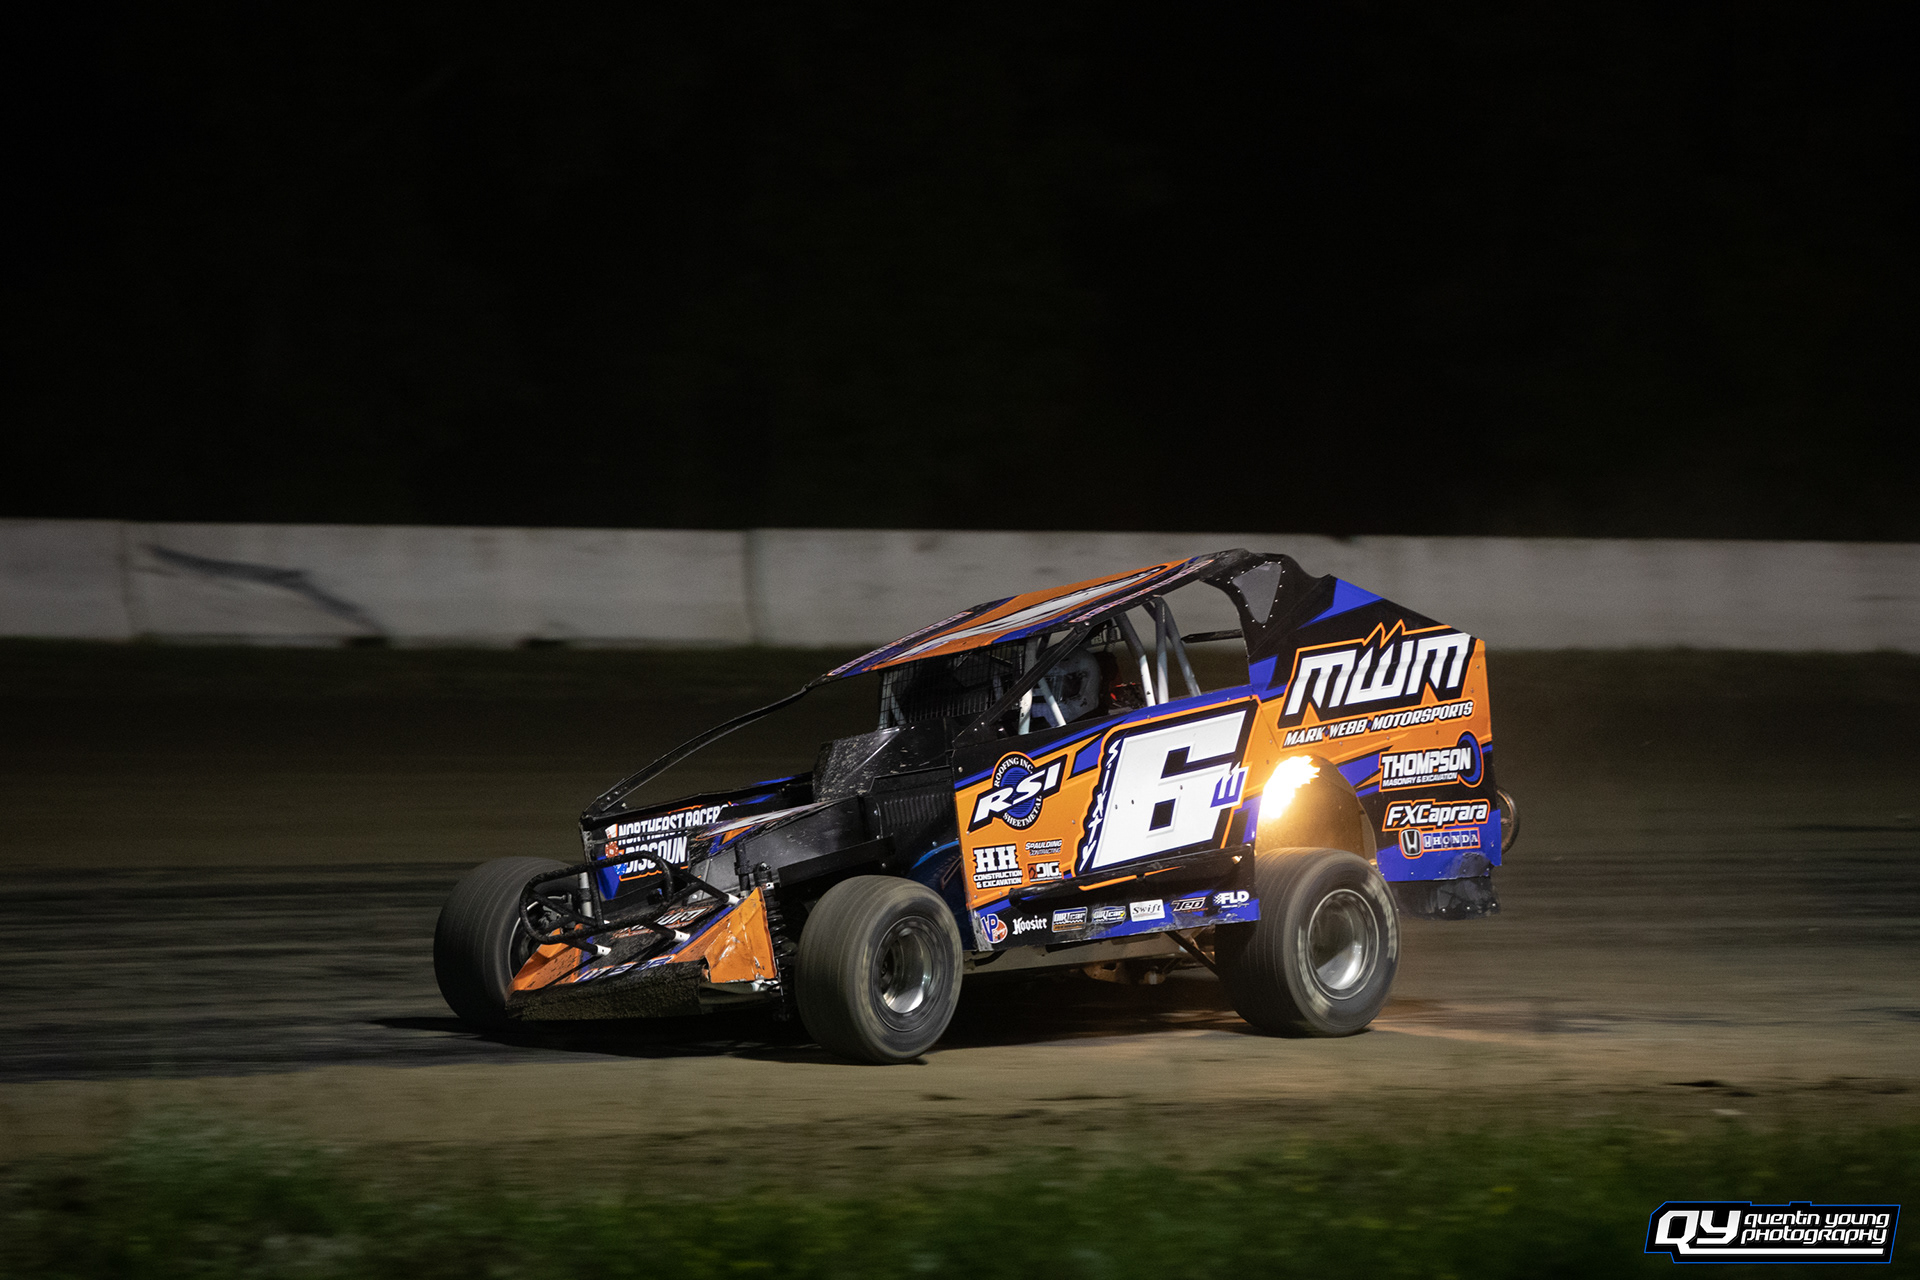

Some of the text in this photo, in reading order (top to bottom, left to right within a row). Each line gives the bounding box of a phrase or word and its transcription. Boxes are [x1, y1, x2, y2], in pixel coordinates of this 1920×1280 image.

[1285, 633, 1471, 715] MWM
[1283, 702, 1474, 747] MARK WEBB MOTORSPORTS
[994, 757, 1034, 787] ROOFING INC.
[1382, 747, 1471, 779] THOMPSON
[973, 762, 1061, 823] RSI
[1091, 710, 1247, 869] 6
[1382, 776, 1416, 787] MASONRY
[1421, 772, 1458, 782] EXCAVATION
[1002, 795, 1042, 827] SHEETMETAL
[1386, 804, 1488, 826] FXCaprara
[1025, 840, 1062, 850] SPAULDING
[1432, 834, 1479, 846] HONDA
[624, 836, 690, 874] DISCOUN
[973, 845, 1019, 873] HH
[973, 869, 1023, 881] CONSTRUCTION
[983, 878, 1022, 888] EXCAVATION
[1132, 904, 1161, 915] Swift
[981, 914, 998, 942] VP
[1012, 915, 1047, 935] Hoosier
